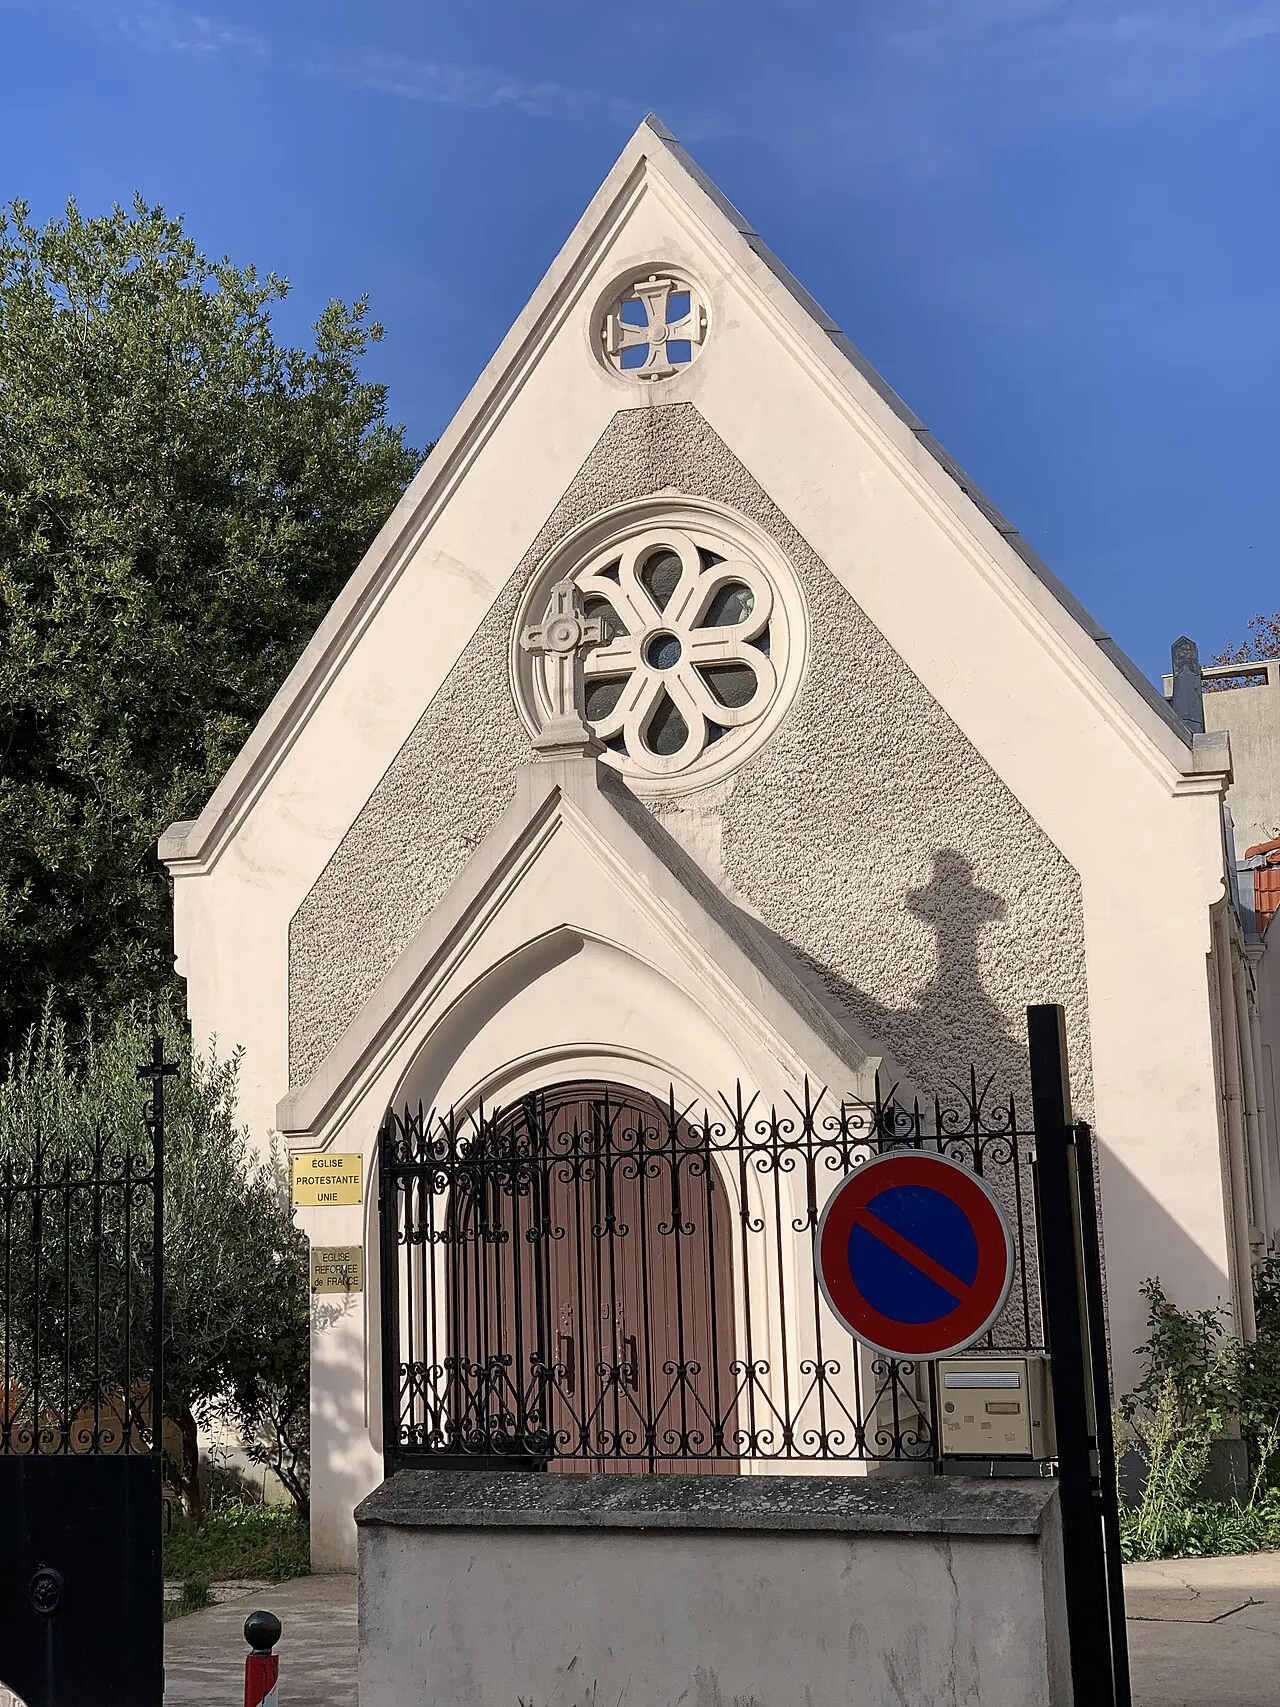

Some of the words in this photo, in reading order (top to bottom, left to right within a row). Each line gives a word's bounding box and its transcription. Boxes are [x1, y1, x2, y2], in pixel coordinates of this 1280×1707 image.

[312, 1158, 343, 1168] ÉGLISE
[296, 1176, 359, 1185] PROTESTANTE
[317, 1193, 338, 1201] UNIE
[323, 1253, 349, 1262] EGLISE
[314, 1278, 323, 1286] de
[327, 1276, 358, 1286] FRANCE
